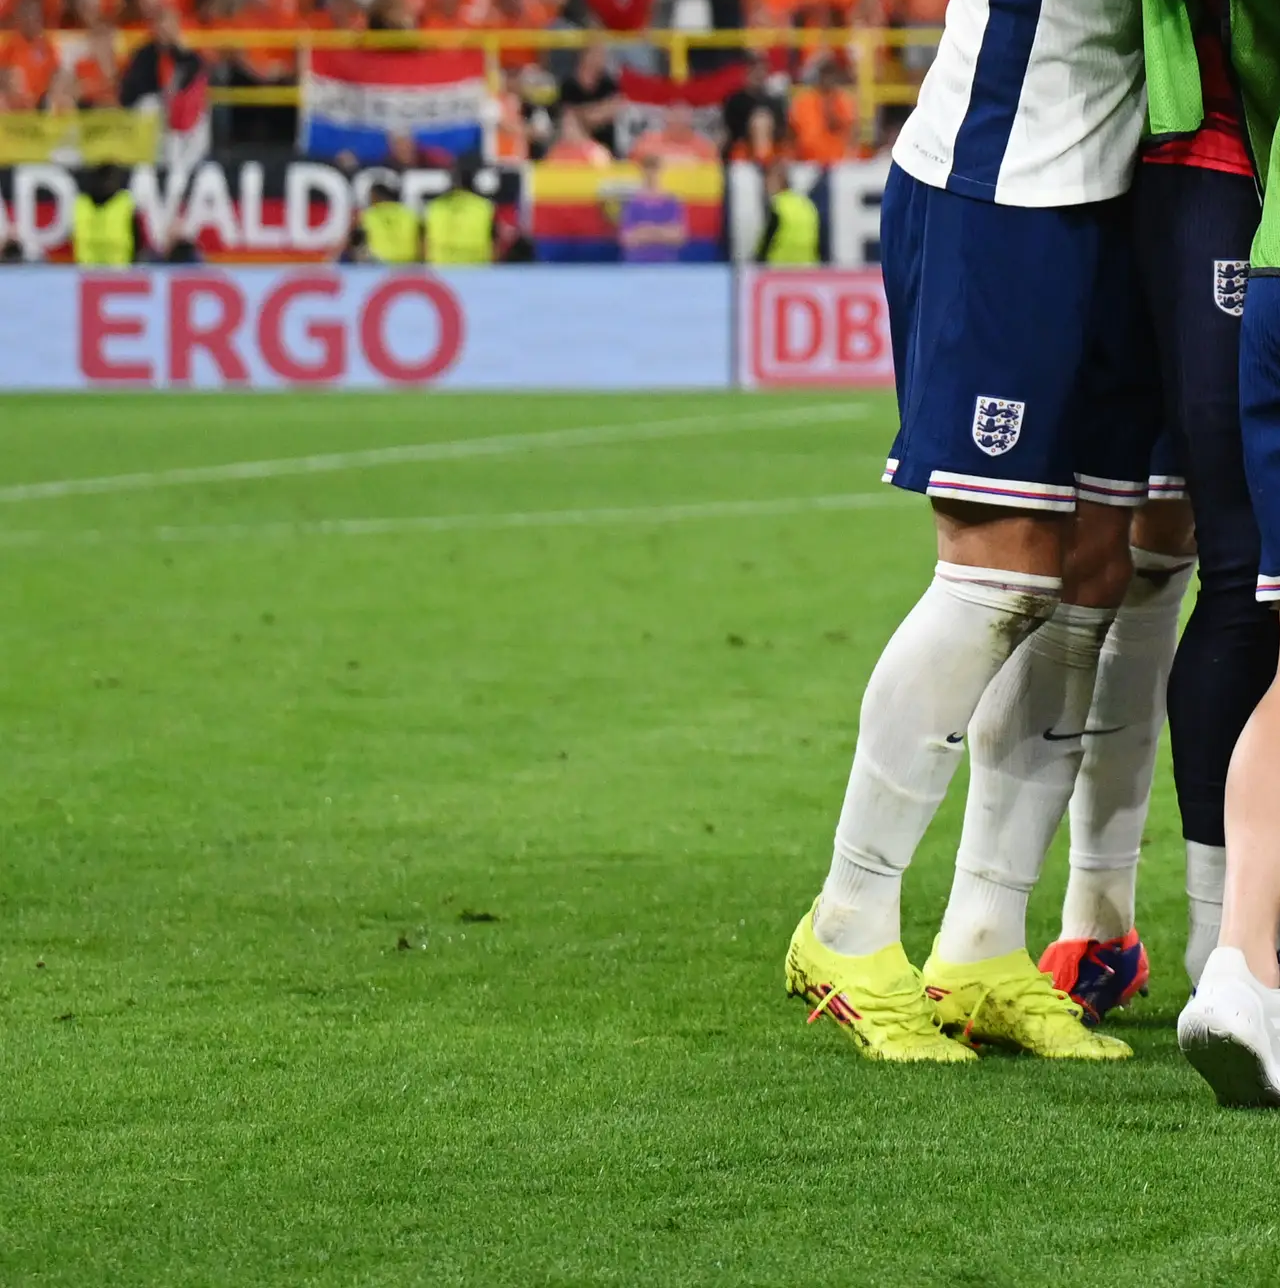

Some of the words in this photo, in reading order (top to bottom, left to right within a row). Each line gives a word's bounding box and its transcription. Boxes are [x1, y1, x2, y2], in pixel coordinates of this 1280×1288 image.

[0, 160, 80, 258] D
[80, 274, 463, 384] ERGO
[774, 294, 884, 364] DB
